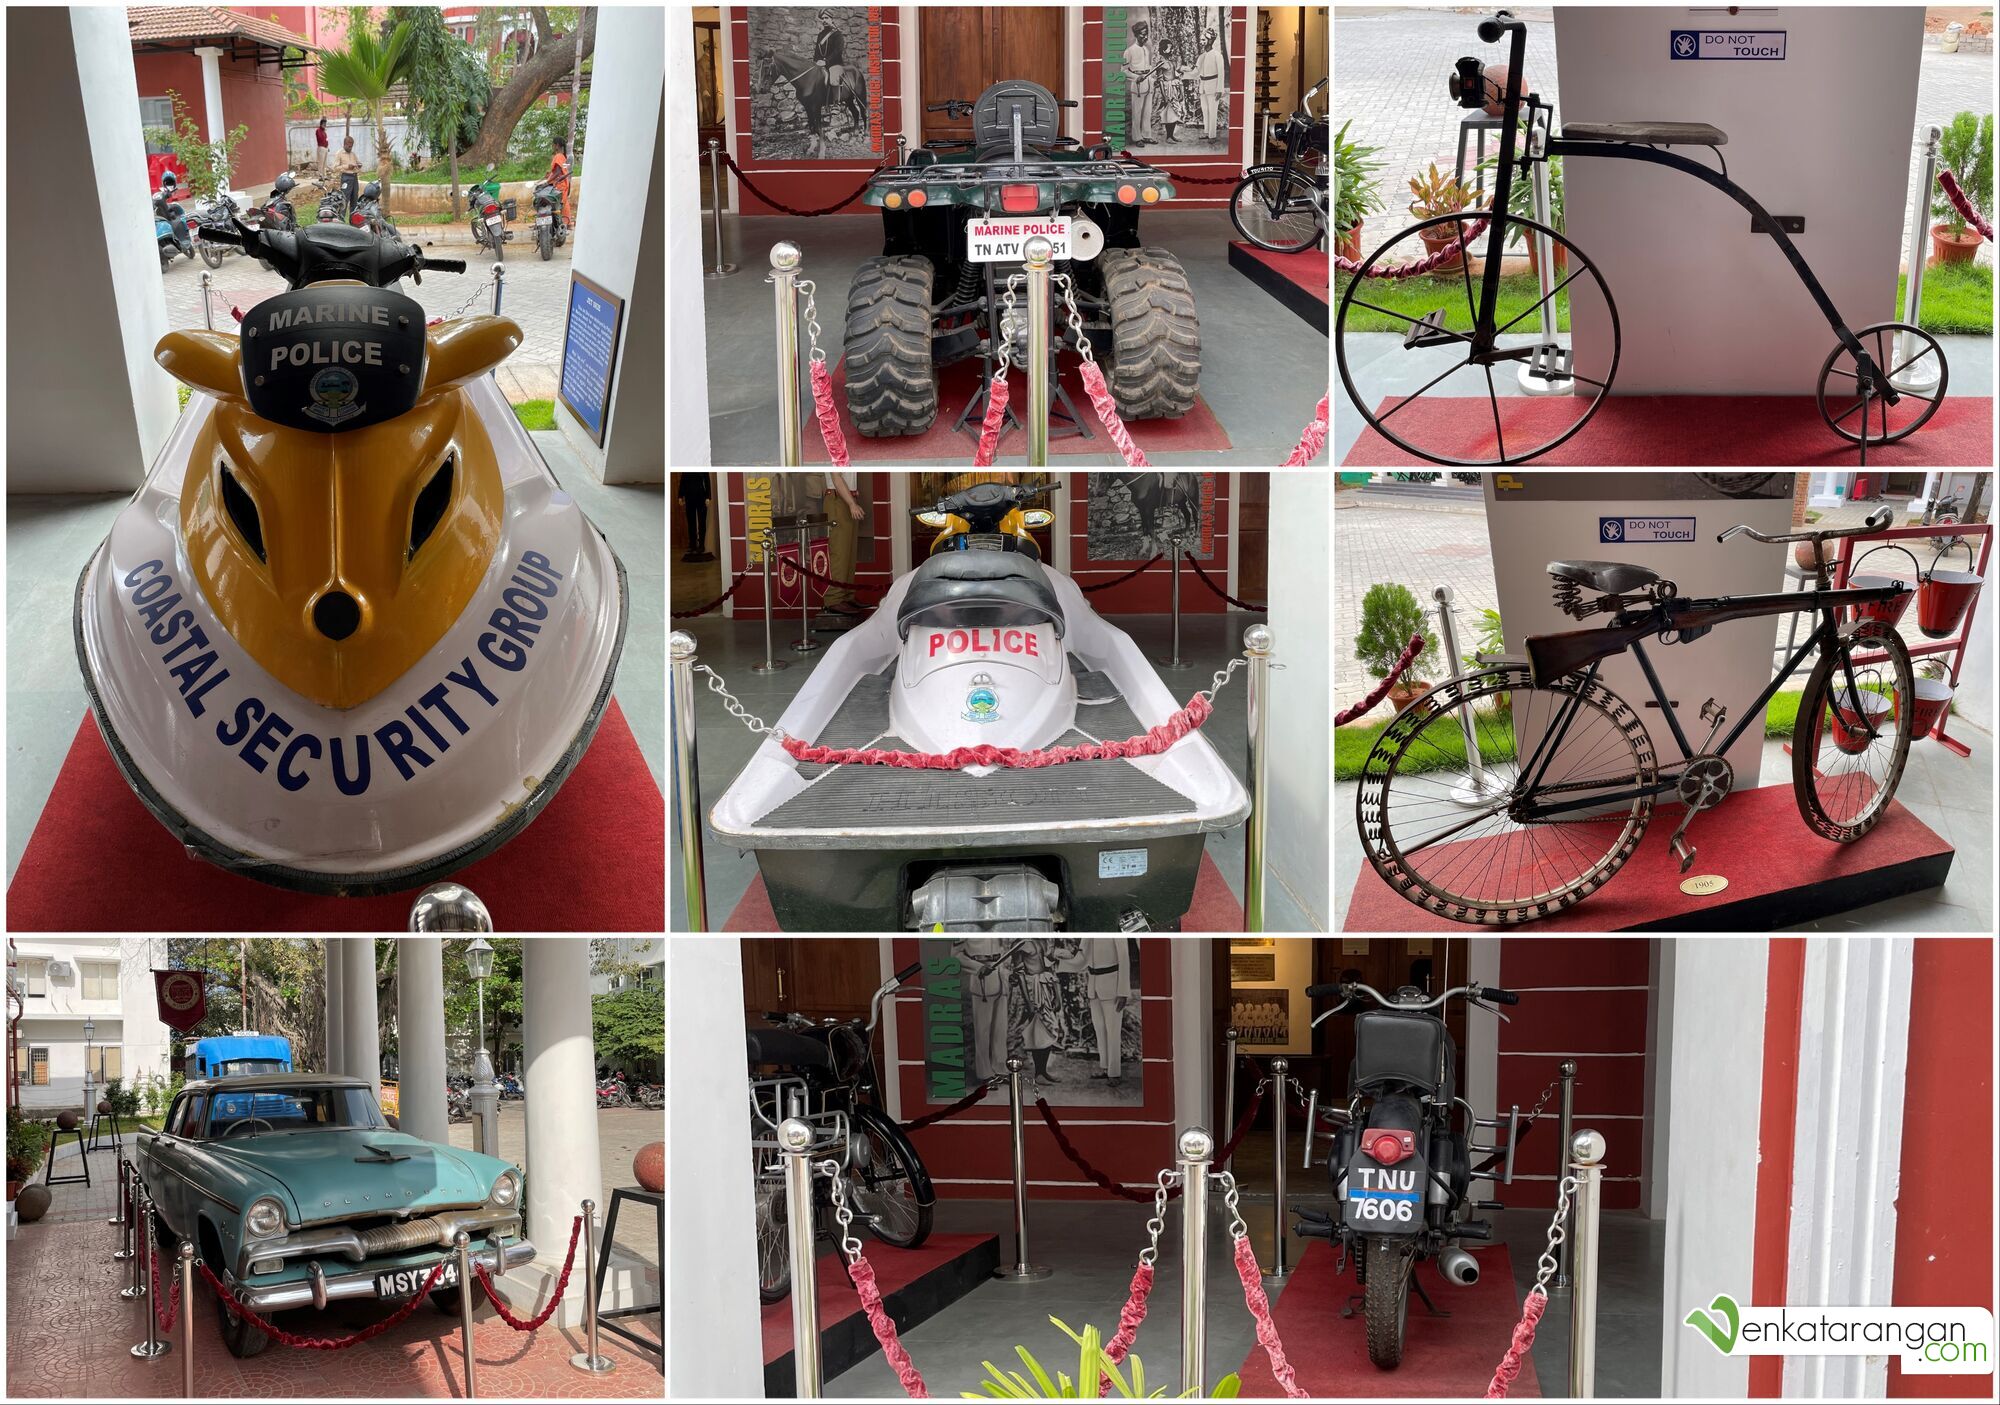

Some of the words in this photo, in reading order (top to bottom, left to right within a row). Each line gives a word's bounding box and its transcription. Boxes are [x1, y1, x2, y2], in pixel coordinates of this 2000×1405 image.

[1705, 35, 1724, 45] DO
[1728, 35, 1756, 45] NOT
[1733, 47, 1779, 56] TOUCH
[1105, 72, 1126, 152] MADRAS
[975, 225, 1020, 236] MARINE
[1023, 224, 1065, 235] POLICE
[975, 244, 991, 256] TN
[995, 243, 1020, 255] ATV
[269, 303, 390, 332] MARINE
[270, 340, 383, 371] POLICE
[1629, 521, 1646, 530] DO
[1649, 521, 1671, 530] NOT
[1653, 531, 1690, 539] TOUCH
[929, 628, 1038, 657] POLICE
[124, 559, 231, 720] COASTAL
[215, 656, 499, 796] SECURITY
[477, 550, 563, 672] GROUP
[1694, 880, 1714, 889] 1905
[927, 956, 966, 1099] MADRAS
[1358, 1168, 1416, 1191] TNU
[1350, 1197, 1413, 1222] 7606
